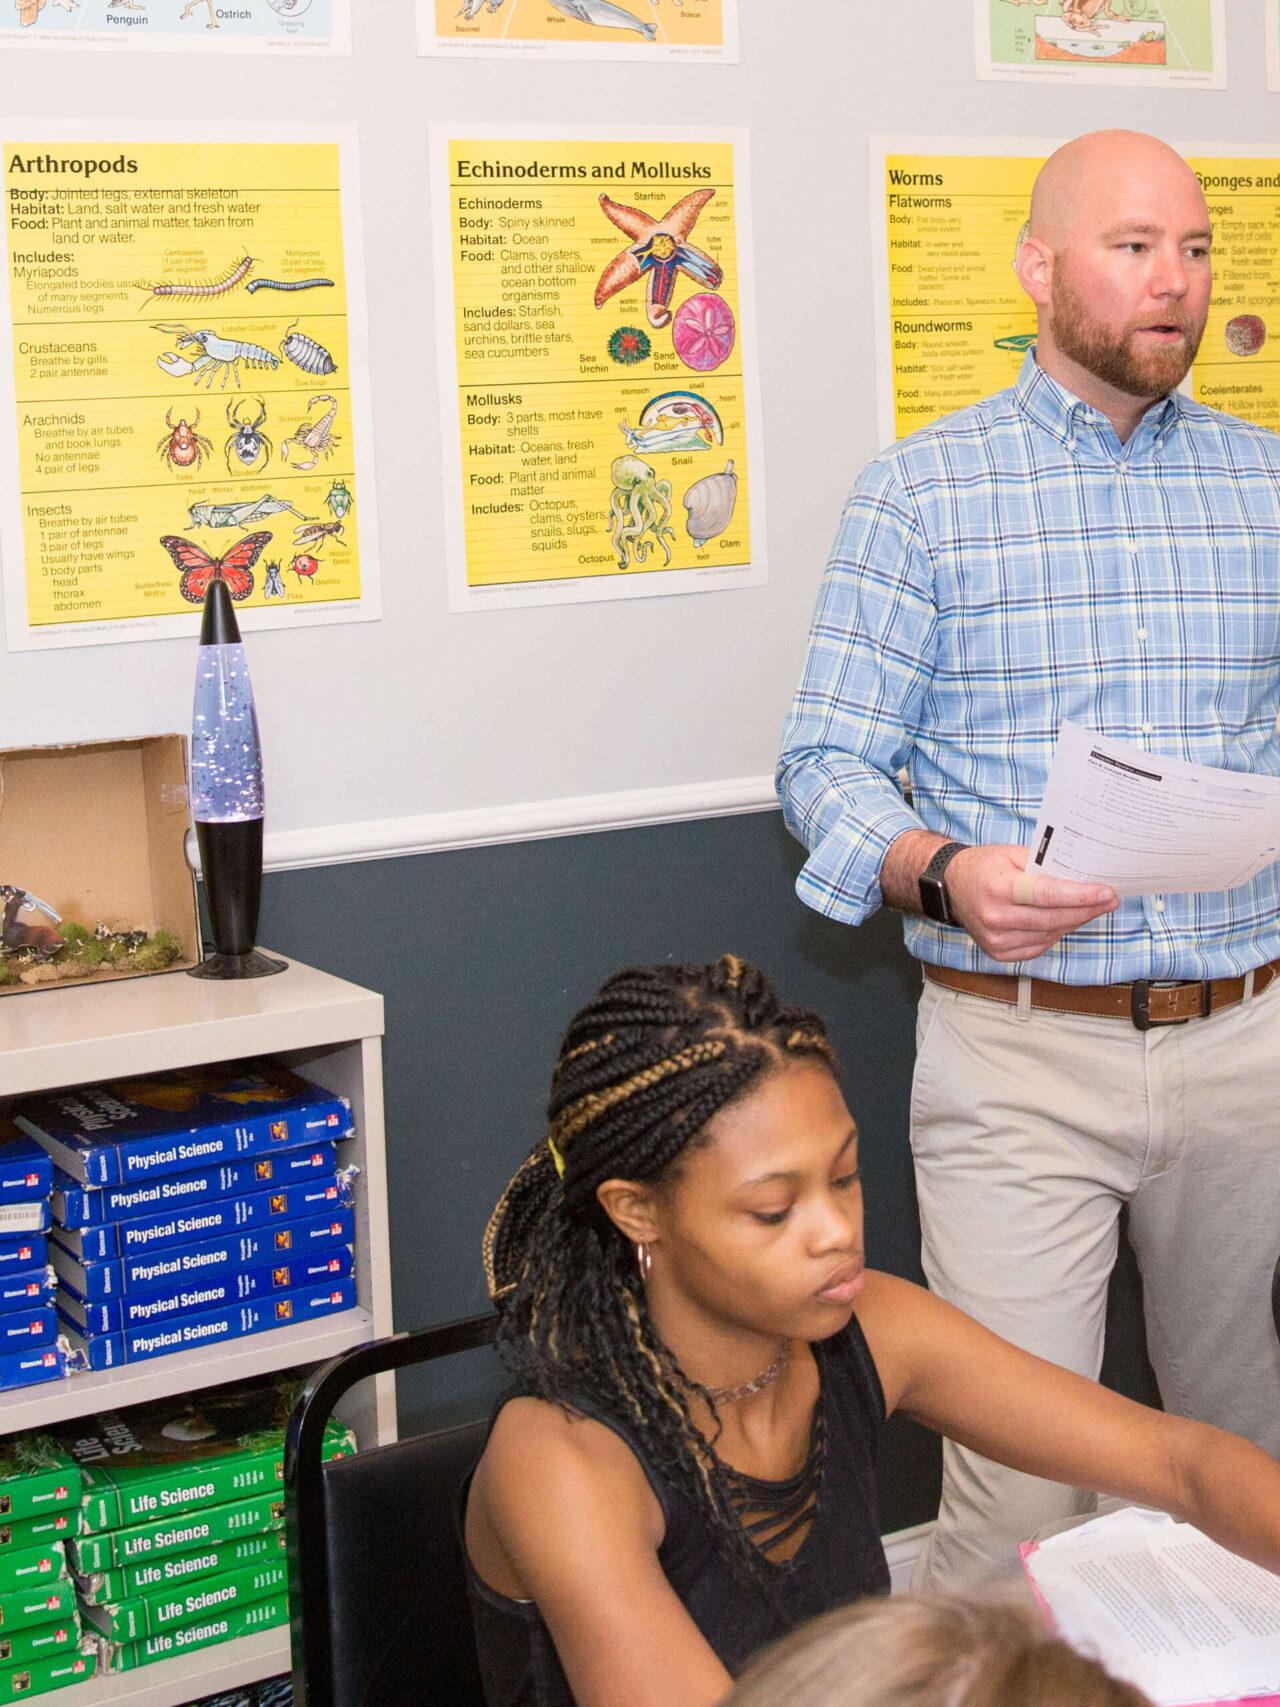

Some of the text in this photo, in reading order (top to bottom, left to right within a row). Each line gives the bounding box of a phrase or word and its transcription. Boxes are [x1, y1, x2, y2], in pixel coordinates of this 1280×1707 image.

[106, 14, 148, 26] Penguin
[216, 9, 251, 20] Ostrich
[455, 25, 480, 34] Squirrel
[8, 154, 138, 178] Arthropods
[457, 161, 711, 178] Echinoderms and Mollusks
[888, 170, 943, 186] Worms
[1256, 173, 1280, 188] and
[10, 189, 238, 202] Body: Jointed legs, external skeleton
[634, 192, 666, 200] Starfish
[889, 195, 952, 208] Flatworms
[11, 202, 260, 216] Habitat: Land, salt water and fresh water
[458, 198, 542, 209] Echinoderms
[12, 216, 254, 230] Food: Plant and animal matter, taken from
[459, 216, 575, 229] Body: Spiny skinned
[53, 232, 135, 244] land or water.
[460, 233, 548, 245] Habitat: Ocean
[13, 251, 74, 262] Includes:
[461, 250, 582, 262] Food: Clams, oysters,
[14, 266, 79, 280] Myriapods
[501, 262, 595, 274] and other shallow
[501, 276, 576, 288] ocean bottom
[502, 289, 559, 303] organisms
[463, 305, 563, 318] Includes: Starfish,
[464, 320, 555, 332] sand dollars, sea
[894, 321, 972, 333] Roundworms
[464, 333, 574, 345] urchins, brittle stars,
[19, 342, 97, 354] Crustaceans
[465, 347, 549, 359] sea cucumbers
[30, 355, 108, 367] Breathe by gills
[580, 354, 596, 363] Sea
[654, 352, 675, 361] Sand
[580, 365, 608, 373] Urchin
[654, 362, 679, 371] Dollar
[1200, 385, 1263, 395] Coelenterates
[467, 394, 522, 407] Mollusks
[23, 412, 85, 426] Arachnids
[467, 409, 603, 426] Body: 3 parts, most have
[507, 426, 539, 437] shells
[469, 439, 594, 456] Habitat: Oceans, fresh
[522, 454, 577, 466] water, land
[470, 468, 596, 485] Food: Plant and animal
[510, 485, 544, 496] matter
[28, 504, 72, 517] Insects
[472, 499, 578, 515] Includes: Octopus,
[530, 511, 607, 525] clams, oysters,
[531, 524, 598, 538] snails, slugs,
[532, 539, 567, 552] squids
[719, 540, 740, 548] Clam
[578, 554, 614, 565] Octopus
[128, 1140, 223, 1170] Physical Science
[111, 1179, 207, 1208] Physical Science
[126, 1214, 222, 1244] Physical Science
[131, 1250, 227, 1281] Physical Science
[130, 1287, 225, 1319] Physical Science
[133, 1321, 228, 1352] Physical Science
[130, 1483, 214, 1513] Life Science
[125, 1524, 209, 1555] Life Science
[135, 1553, 218, 1586] Life Science
[158, 1586, 237, 1622] Life Science
[147, 1621, 228, 1655] Life Science
